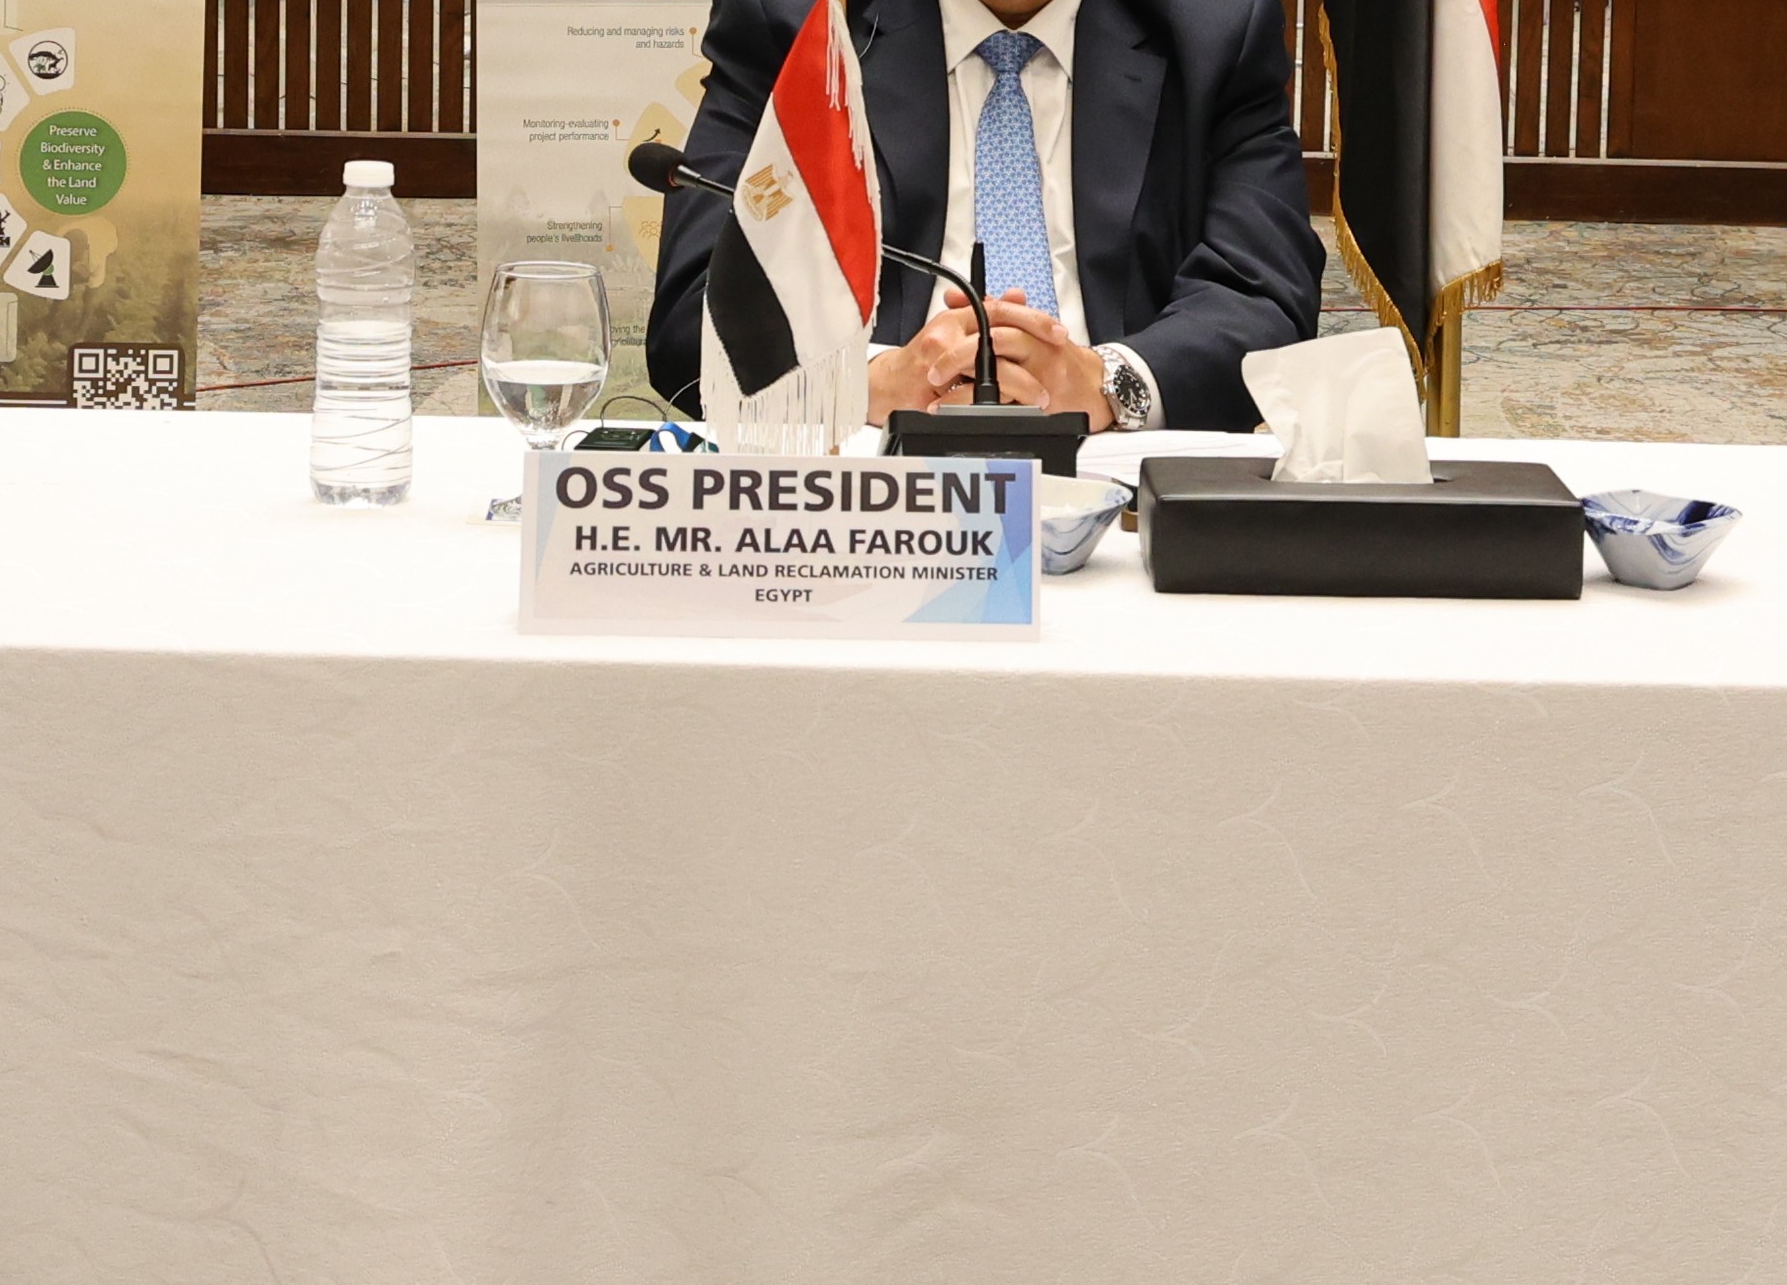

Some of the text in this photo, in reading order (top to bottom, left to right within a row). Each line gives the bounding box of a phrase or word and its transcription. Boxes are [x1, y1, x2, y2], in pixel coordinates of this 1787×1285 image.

[555, 467, 1016, 513] OSS PRESIDENT
[575, 525, 993, 555] H.E. MR. ALAA FAROUK
[569, 562, 997, 580] AGRICULTURE & LAND RECLAMATION MINISTER
[755, 588, 812, 602] EGYPT
